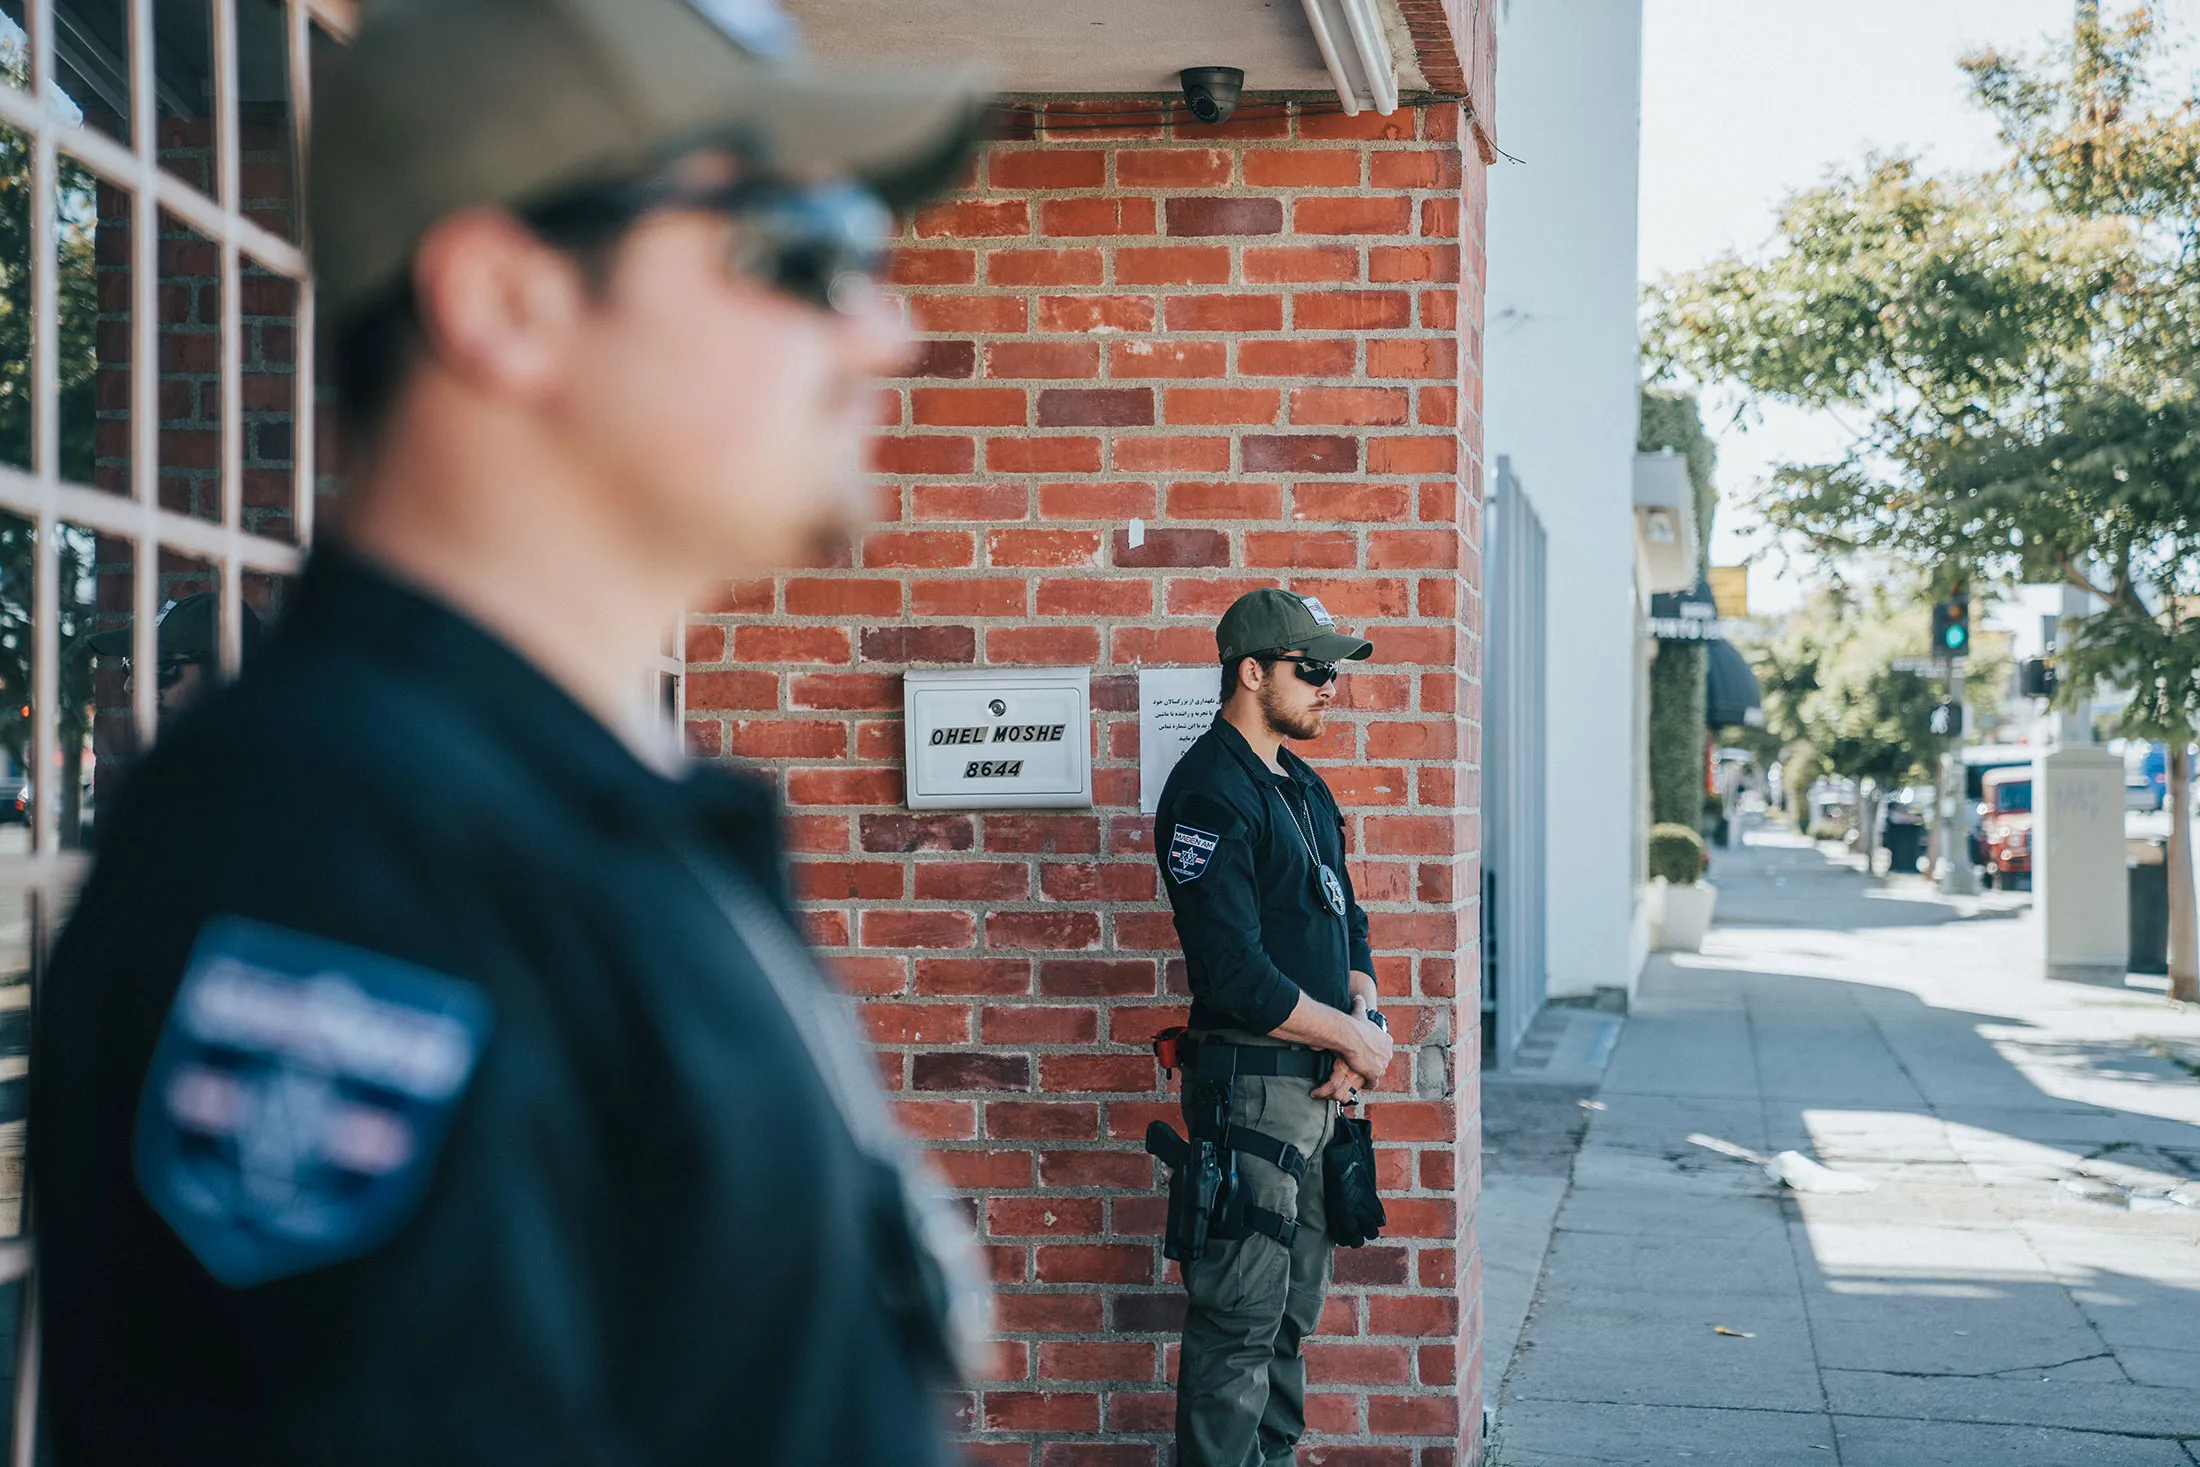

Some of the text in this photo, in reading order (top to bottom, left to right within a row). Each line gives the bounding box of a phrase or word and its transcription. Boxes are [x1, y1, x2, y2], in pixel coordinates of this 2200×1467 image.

[931, 725, 1065, 745] OHEL MOSHE
[966, 761, 1021, 777] 8644
